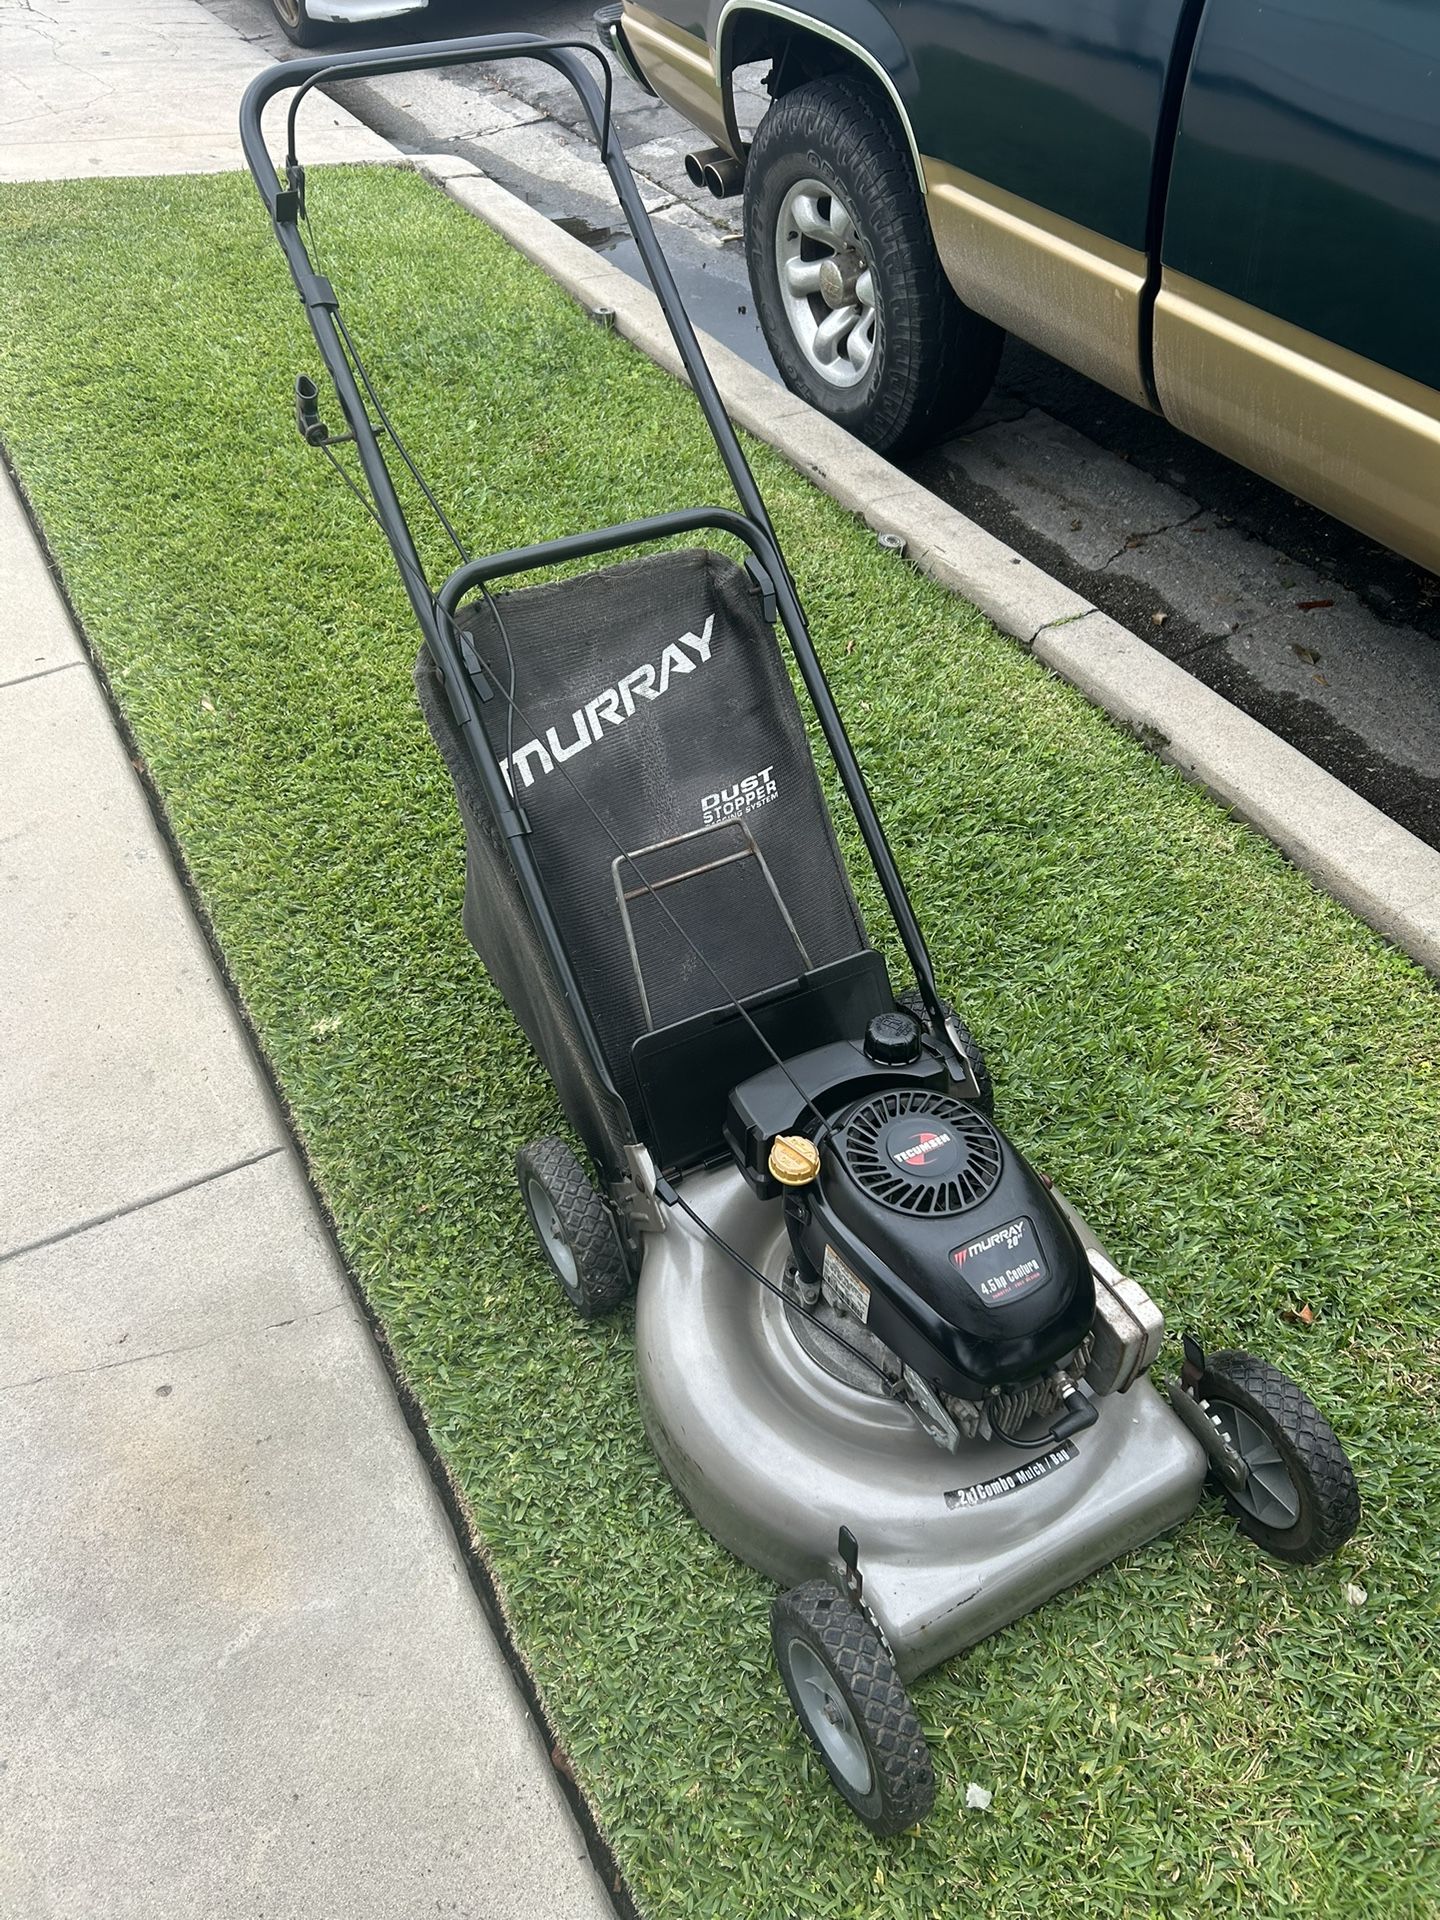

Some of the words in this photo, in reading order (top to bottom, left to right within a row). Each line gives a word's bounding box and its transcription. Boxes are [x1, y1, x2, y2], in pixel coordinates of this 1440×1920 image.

[499, 613, 715, 798] MURRAY
[701, 765, 774, 812] DUST
[703, 779, 777, 824] STOPPER
[745, 791, 779, 814] SYSTEM
[968, 1221, 1024, 1258] MURRAY
[1015, 1463, 1046, 1484] Mulch
[1050, 1448, 1070, 1466] Bag
